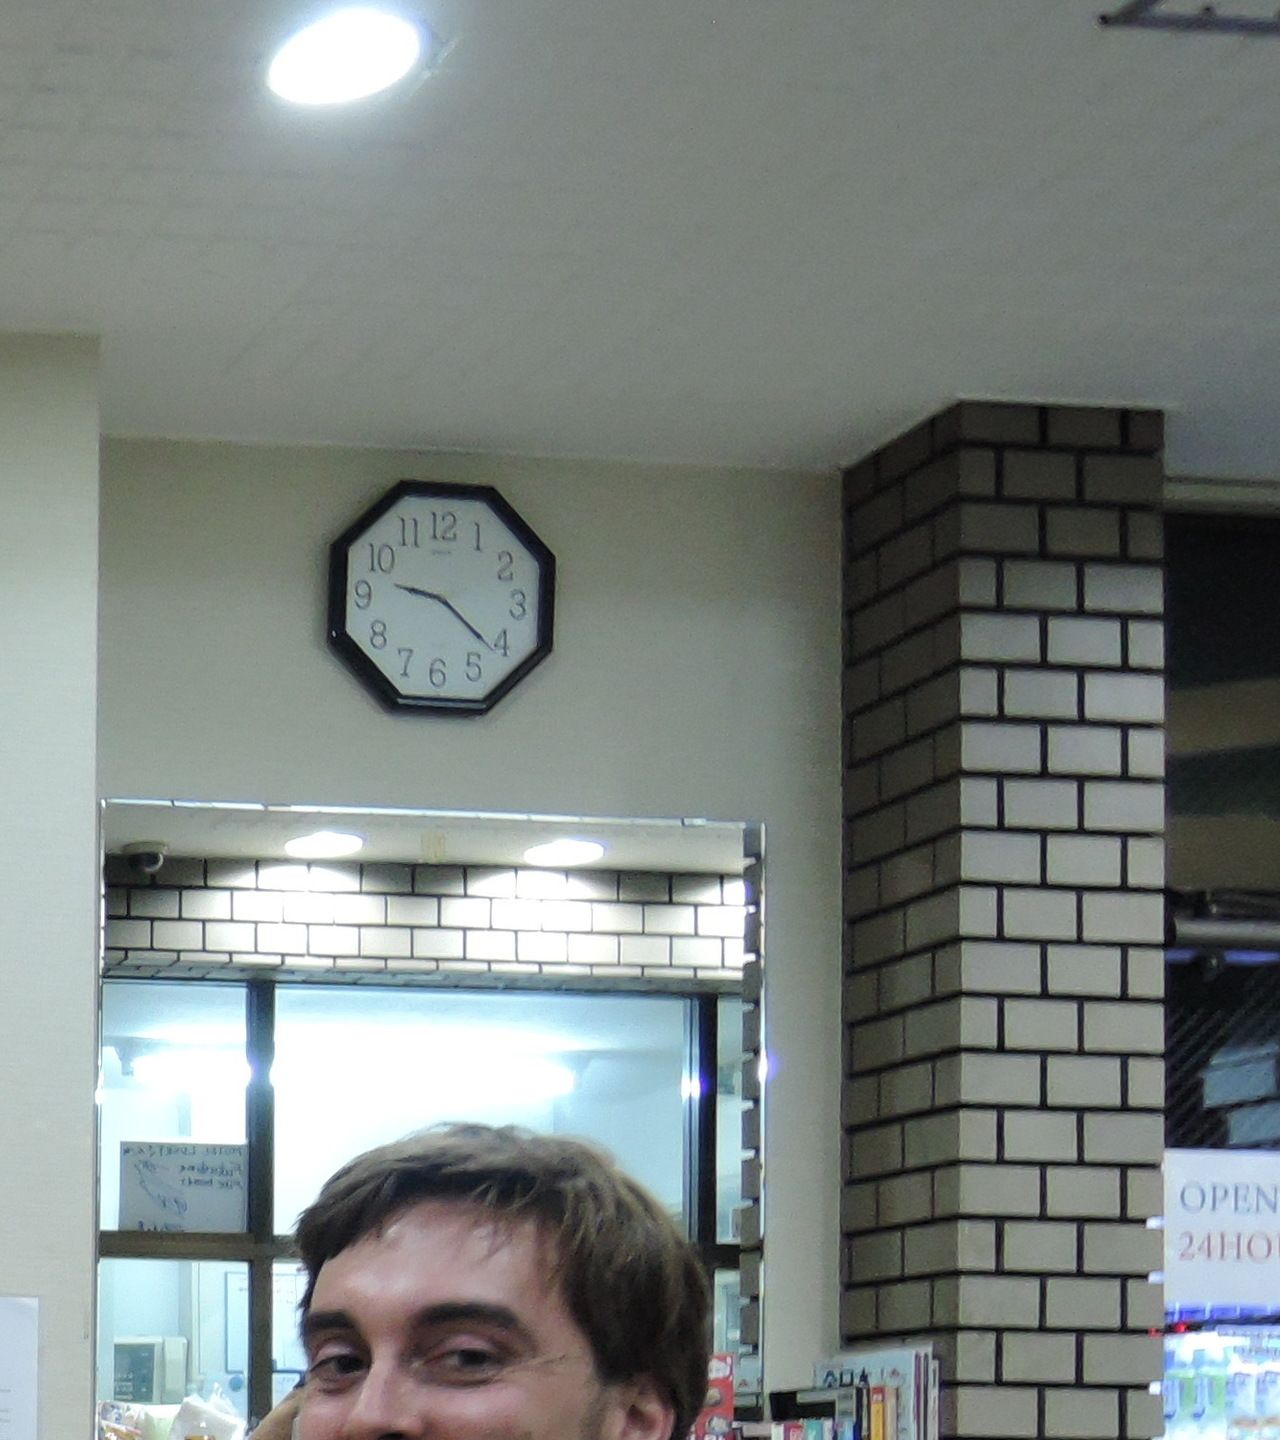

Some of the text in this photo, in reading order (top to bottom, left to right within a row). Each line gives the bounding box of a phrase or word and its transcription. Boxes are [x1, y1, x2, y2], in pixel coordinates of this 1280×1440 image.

[399, 516, 420, 548] 11
[430, 511, 457, 542] 12
[474, 522, 483, 552] 1
[369, 543, 395, 574] 10
[497, 551, 514, 582] 2
[354, 579, 372, 609] 9
[509, 589, 526, 620] 3
[369, 619, 387, 649] 8
[493, 629, 510, 657] 4
[397, 649, 414, 678] 7
[428, 658, 447, 688] 6
[465, 652, 482, 682] 5
[1180, 1182, 1278, 1214] OPEN
[1179, 1230, 1280, 1264] 24HO
